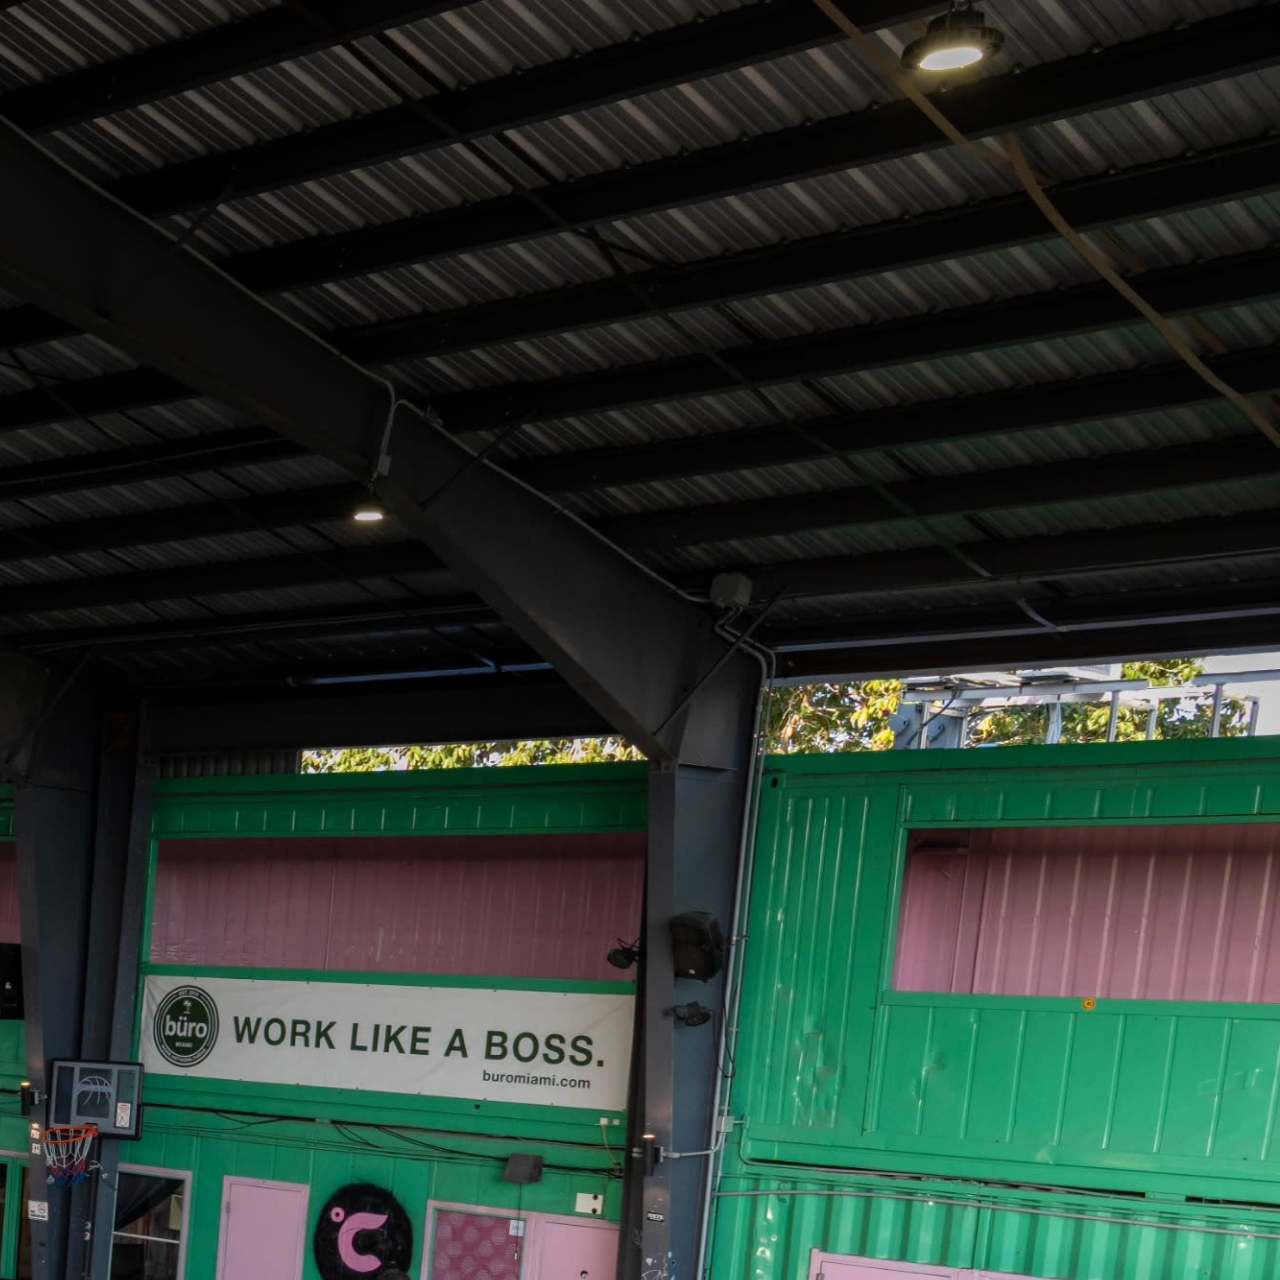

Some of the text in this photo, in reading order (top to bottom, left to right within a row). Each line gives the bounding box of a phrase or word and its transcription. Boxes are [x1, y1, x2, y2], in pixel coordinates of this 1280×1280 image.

[164, 1014, 208, 1039] büro
[233, 1015, 605, 1068] WORK LIKE A BOSS.
[482, 1069, 591, 1090] buromiami.com
